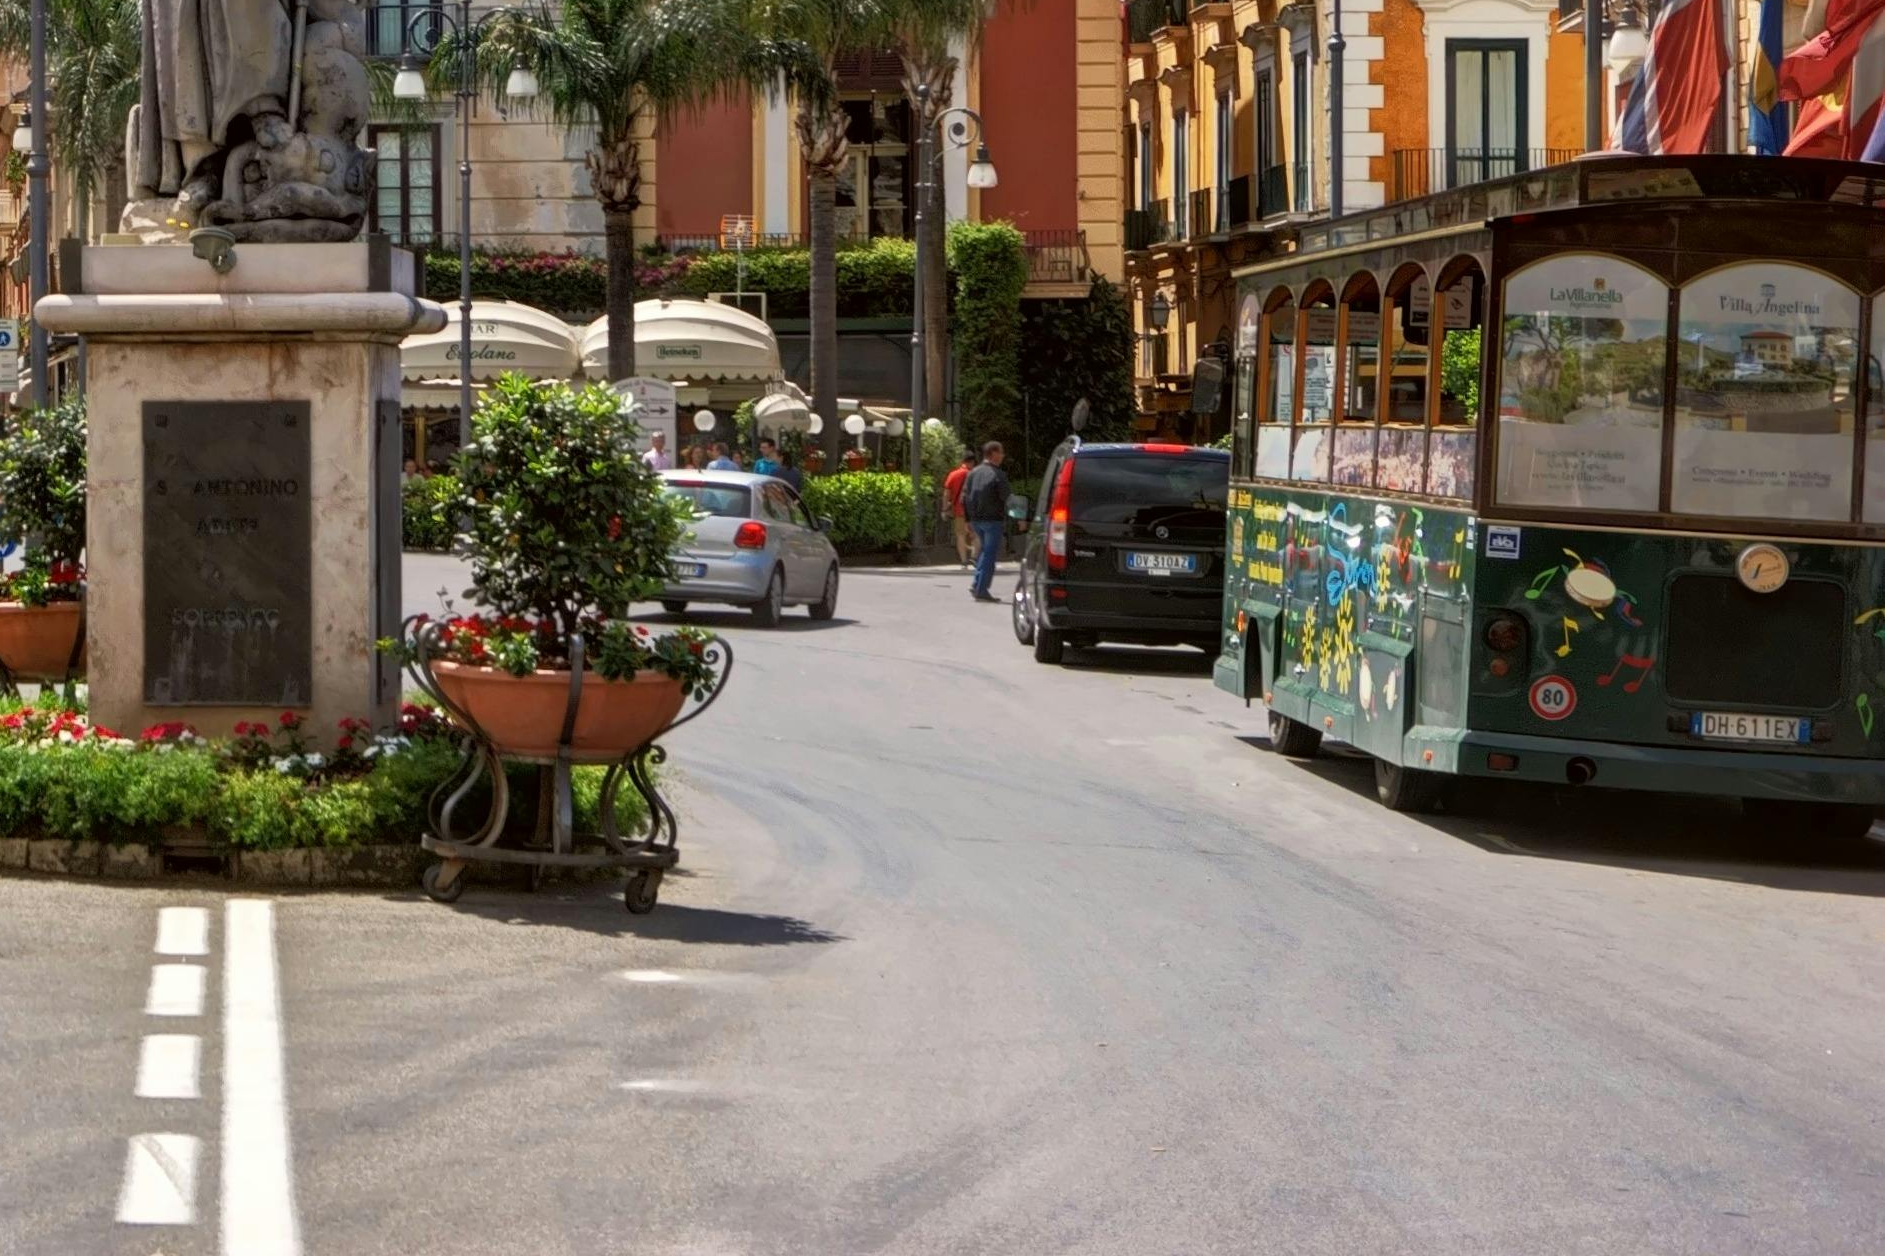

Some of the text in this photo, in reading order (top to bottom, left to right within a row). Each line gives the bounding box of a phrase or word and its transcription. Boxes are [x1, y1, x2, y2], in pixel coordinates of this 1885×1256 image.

[1719, 295, 1820, 317] Villa Angelina
[659, 344, 699, 356] Heineken
[1542, 688, 1564, 707] 80
